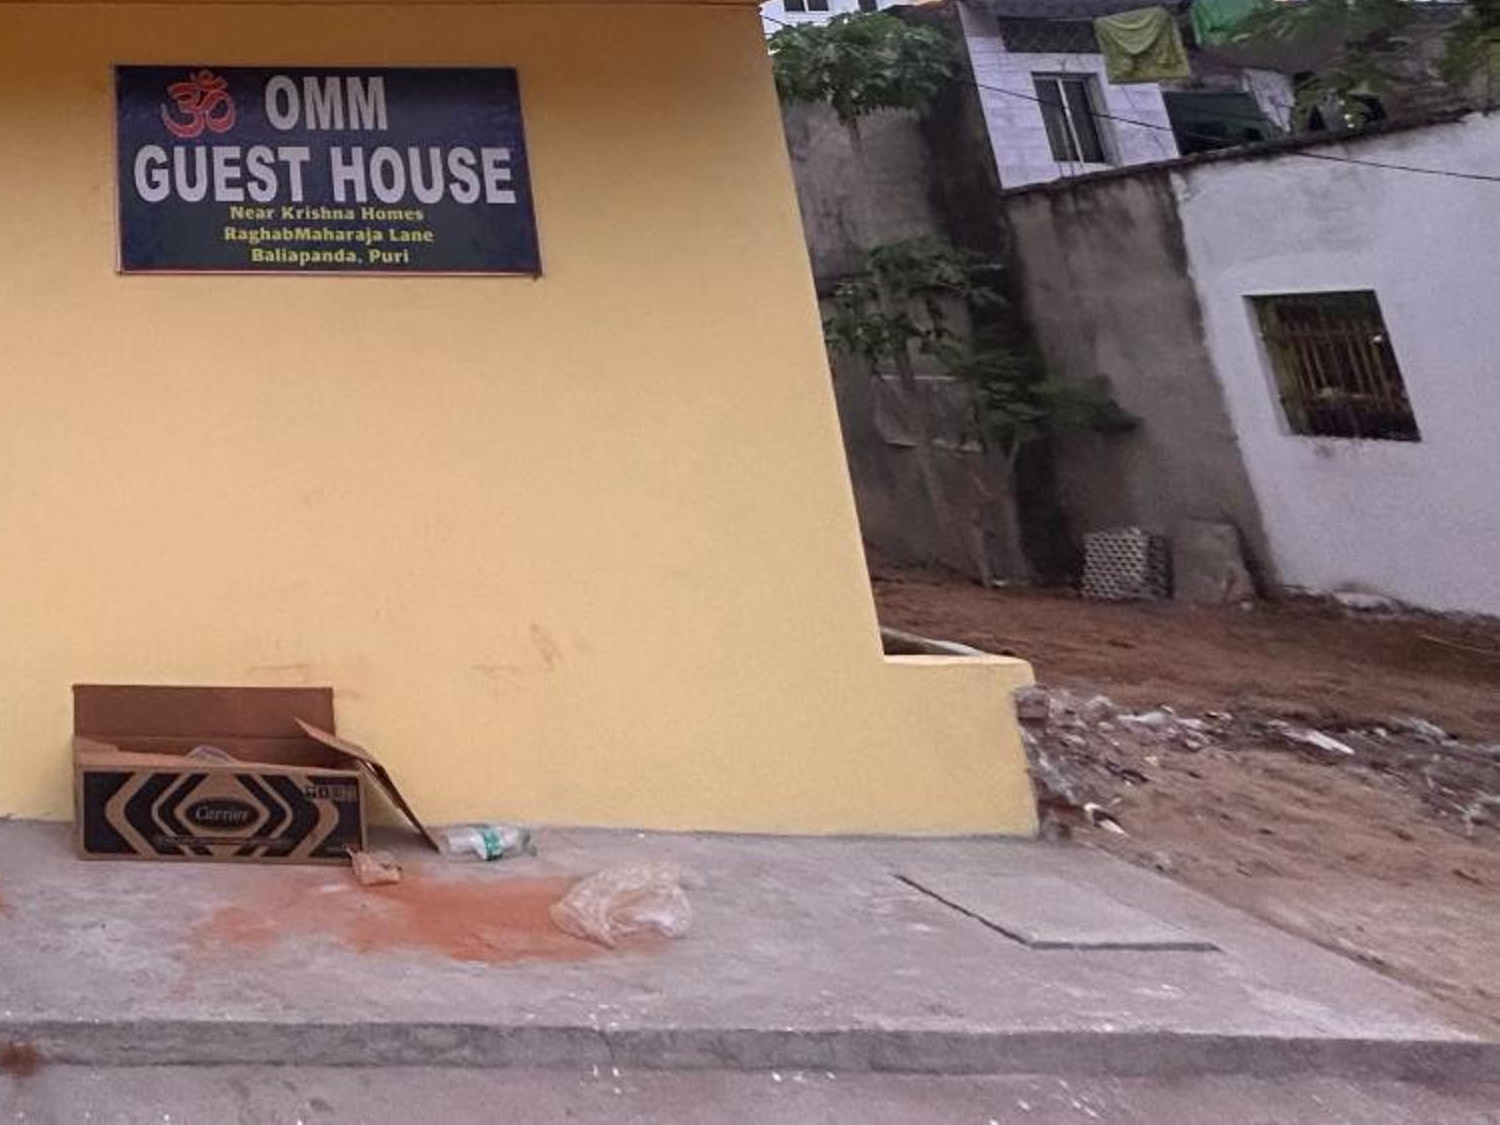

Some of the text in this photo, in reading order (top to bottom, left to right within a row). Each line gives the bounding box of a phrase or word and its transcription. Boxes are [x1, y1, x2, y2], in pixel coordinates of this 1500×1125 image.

[265, 75, 389, 131] OMM
[134, 144, 517, 205] GUEST HOUSE
[229, 205, 424, 221] Near Krishna Homes
[389, 227, 434, 242] Lane
[369, 248, 409, 263] Puri
